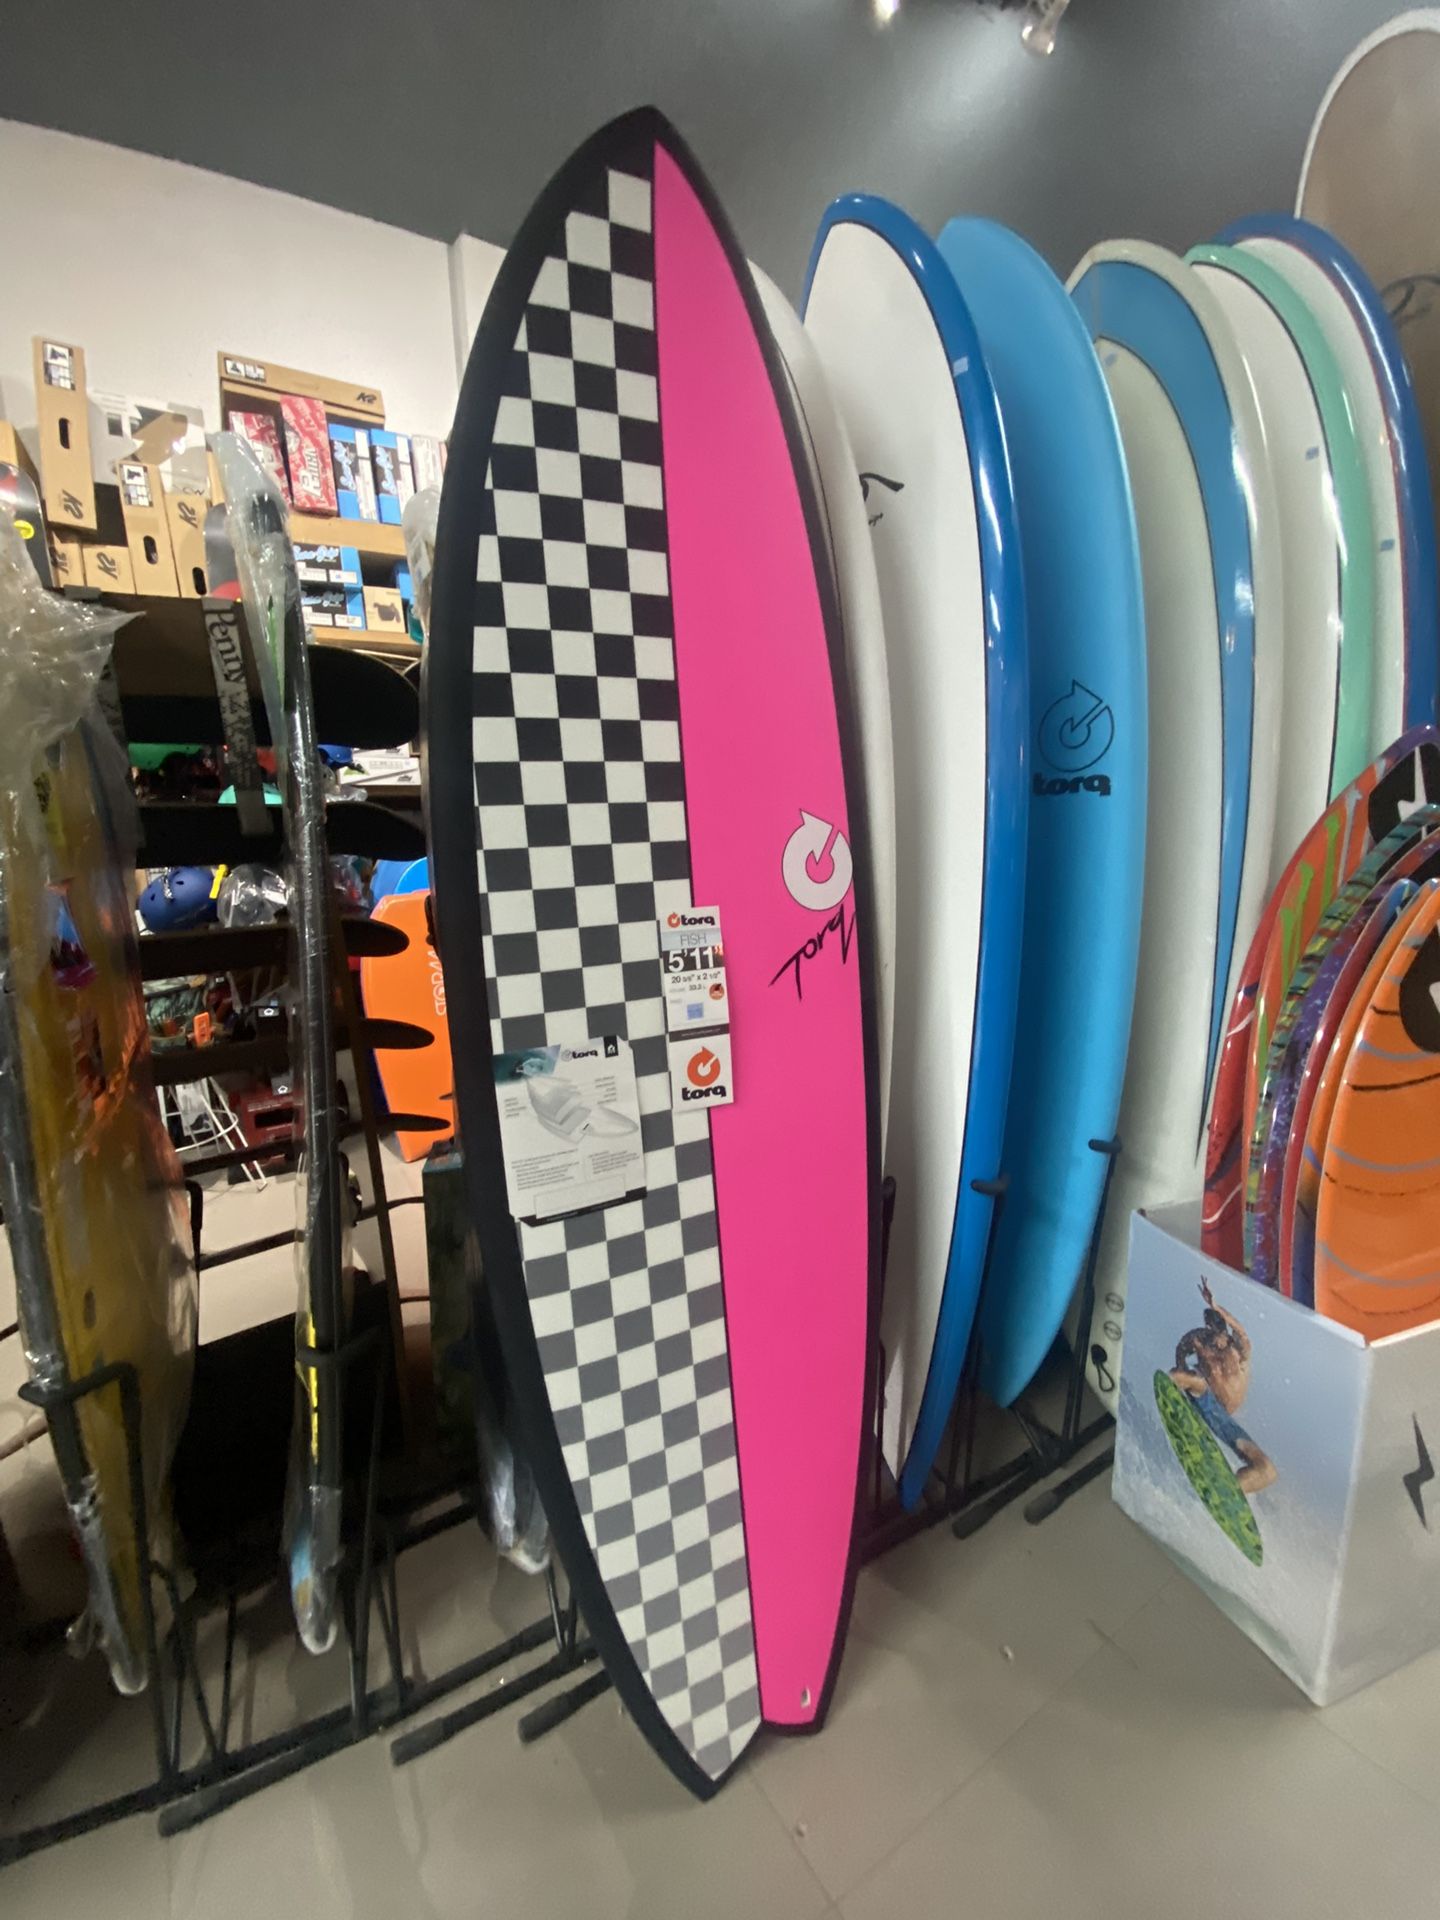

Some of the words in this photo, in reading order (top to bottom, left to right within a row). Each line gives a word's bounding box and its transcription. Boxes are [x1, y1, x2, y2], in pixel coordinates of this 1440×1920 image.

[356, 391, 377, 404] K2
[62, 490, 83, 520] K2
[177, 501, 199, 528] K2
[96, 551, 118, 580] K2
[204, 611, 247, 684] Penny
[1033, 772, 1111, 797] torq
[681, 914, 715, 926] torq
[680, 932, 707, 946] FISH
[672, 975, 681, 984] 20
[572, 1049, 599, 1059] torq
[682, 1085, 727, 1101] torq
